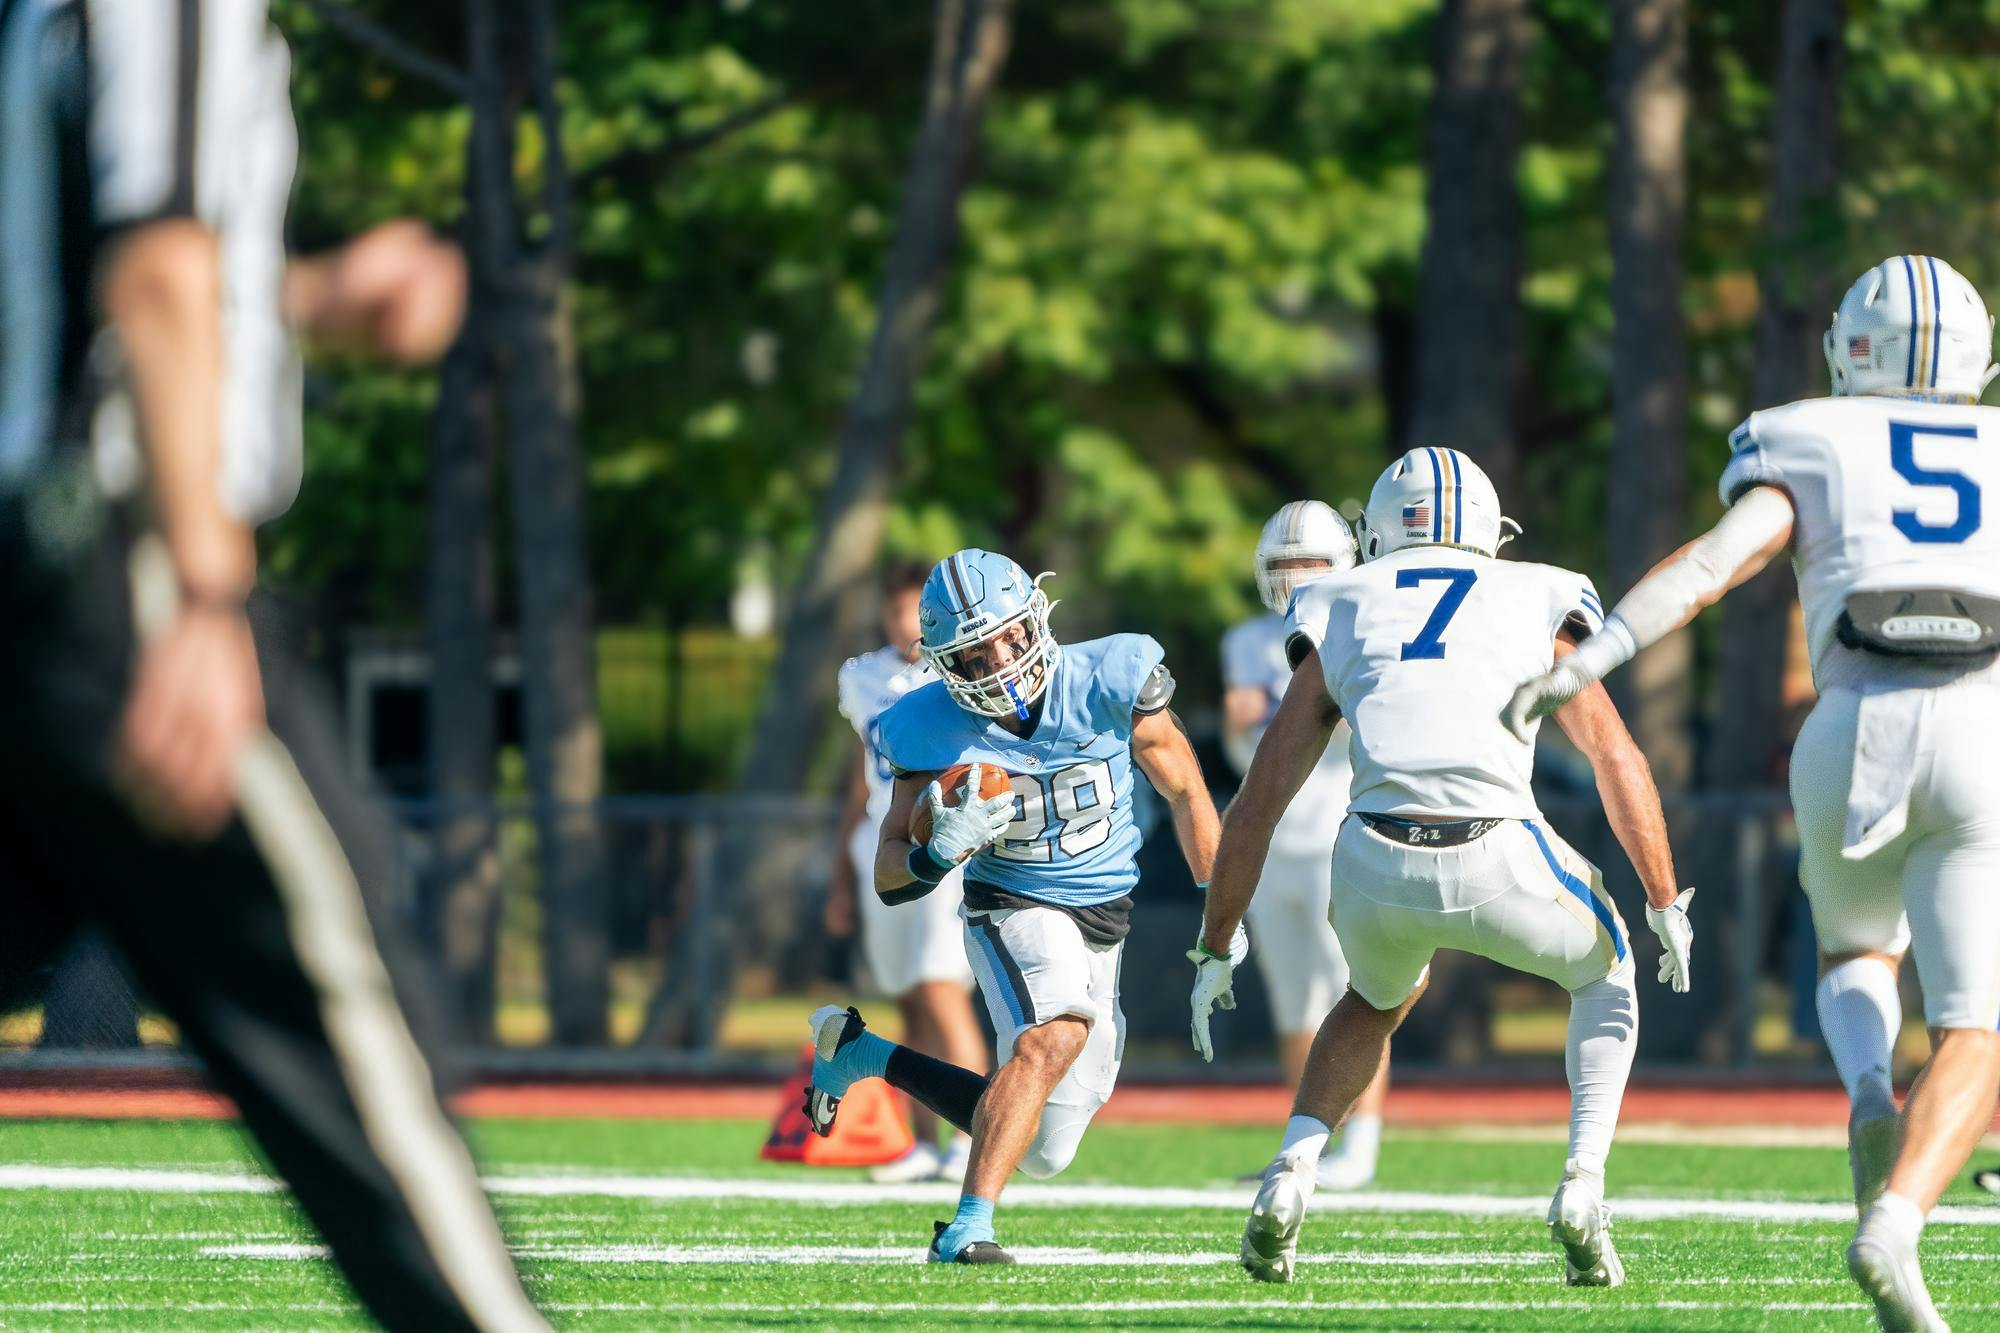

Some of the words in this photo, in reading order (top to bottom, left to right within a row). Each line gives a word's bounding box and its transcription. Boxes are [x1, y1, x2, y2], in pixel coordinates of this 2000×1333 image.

[1888, 419, 1982, 544] 5
[1395, 567, 1478, 662] 7
[989, 757, 1118, 864] 28
